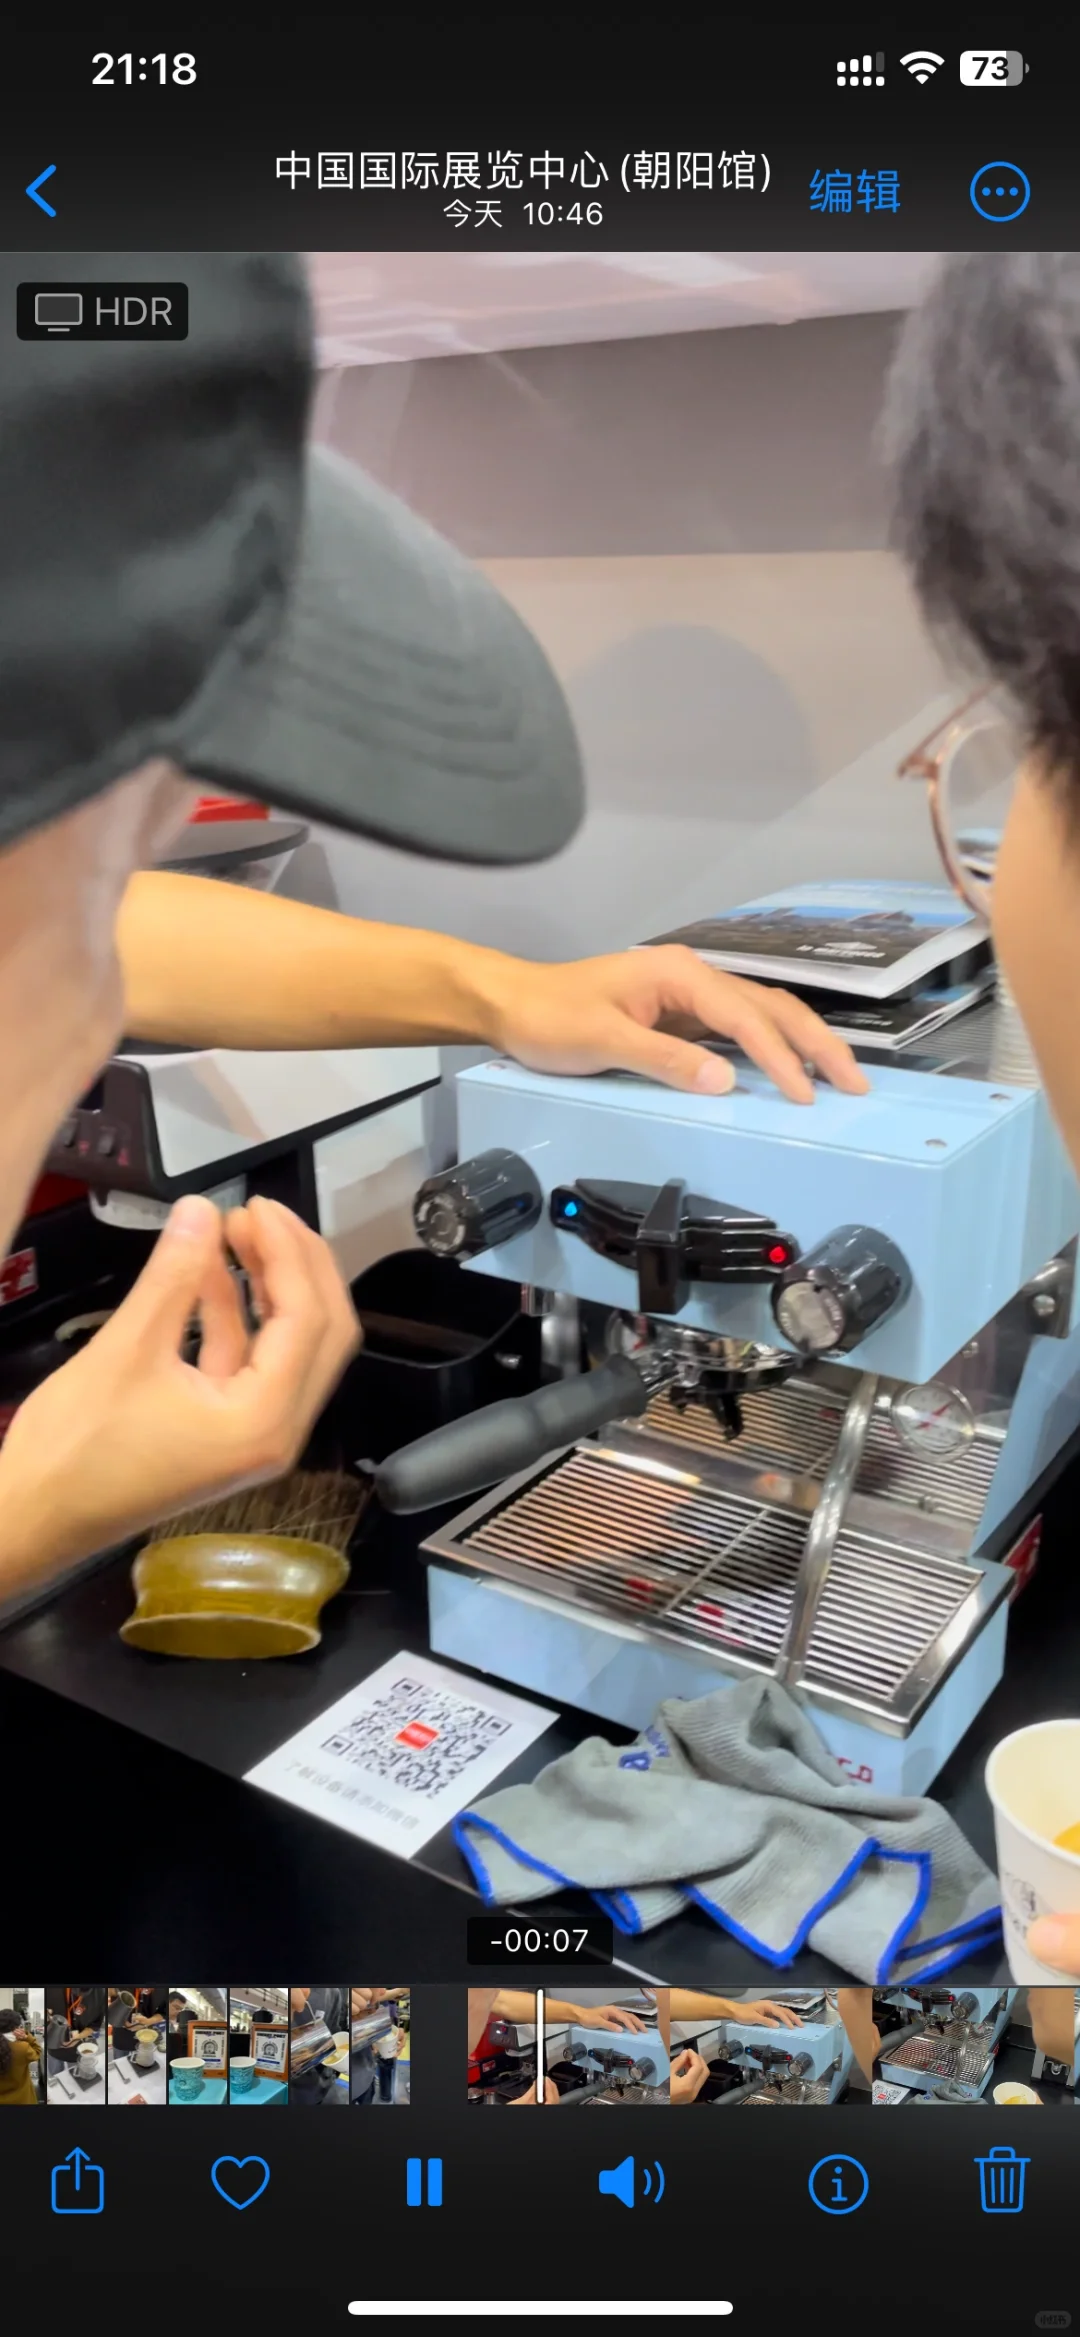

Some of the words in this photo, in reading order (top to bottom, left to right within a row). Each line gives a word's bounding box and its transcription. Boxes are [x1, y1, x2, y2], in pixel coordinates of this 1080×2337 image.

[91, 52, 197, 86] 21:18
[971, 55, 1010, 81] 73
[809, 168, 901, 213] 编辑
[442, 198, 503, 228] 今天
[522, 201, 603, 226] 10:46
[95, 297, 173, 326] HDR
[490, 1928, 589, 1953] -00:07
